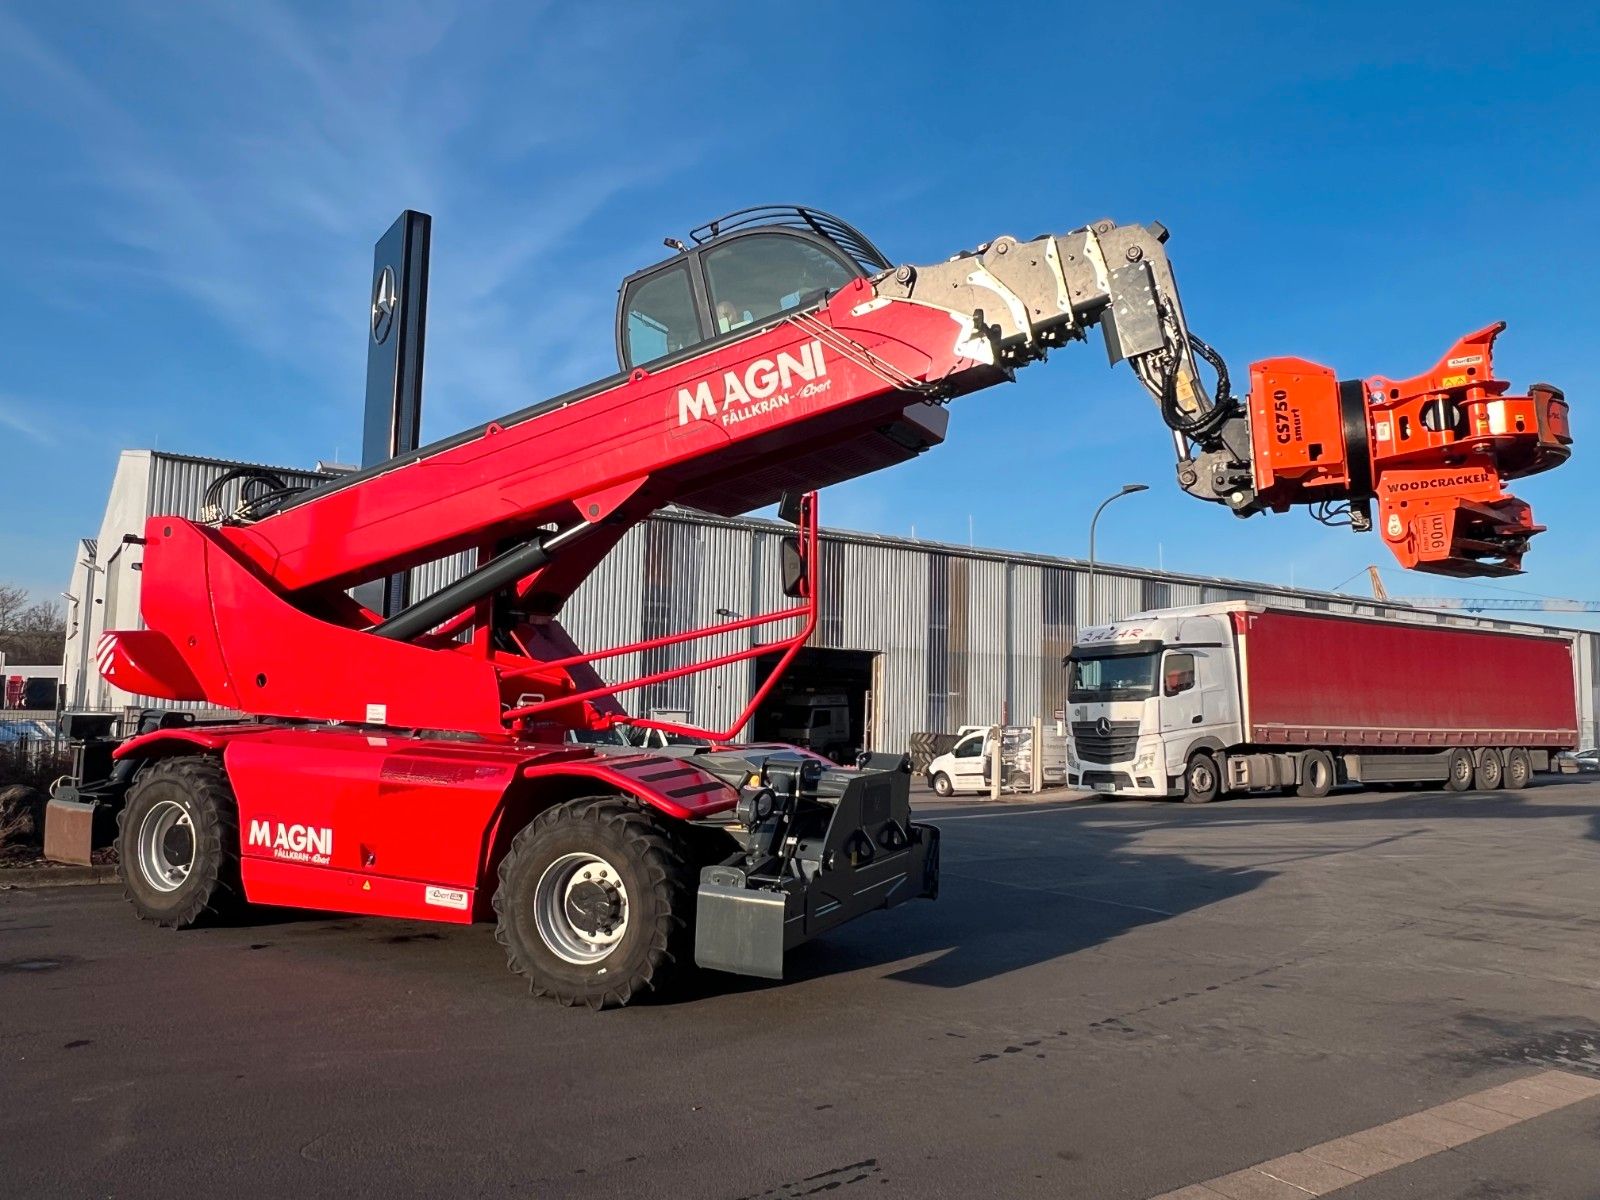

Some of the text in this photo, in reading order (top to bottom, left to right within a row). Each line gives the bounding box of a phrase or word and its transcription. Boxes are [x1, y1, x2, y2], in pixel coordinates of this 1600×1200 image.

[678, 340, 827, 426] MAGNI
[1273, 390, 1291, 444] CS750
[1290, 408, 1303, 442] smart
[1387, 473, 1490, 493] WOODCRACKER
[248, 819, 333, 855] MAGNI
